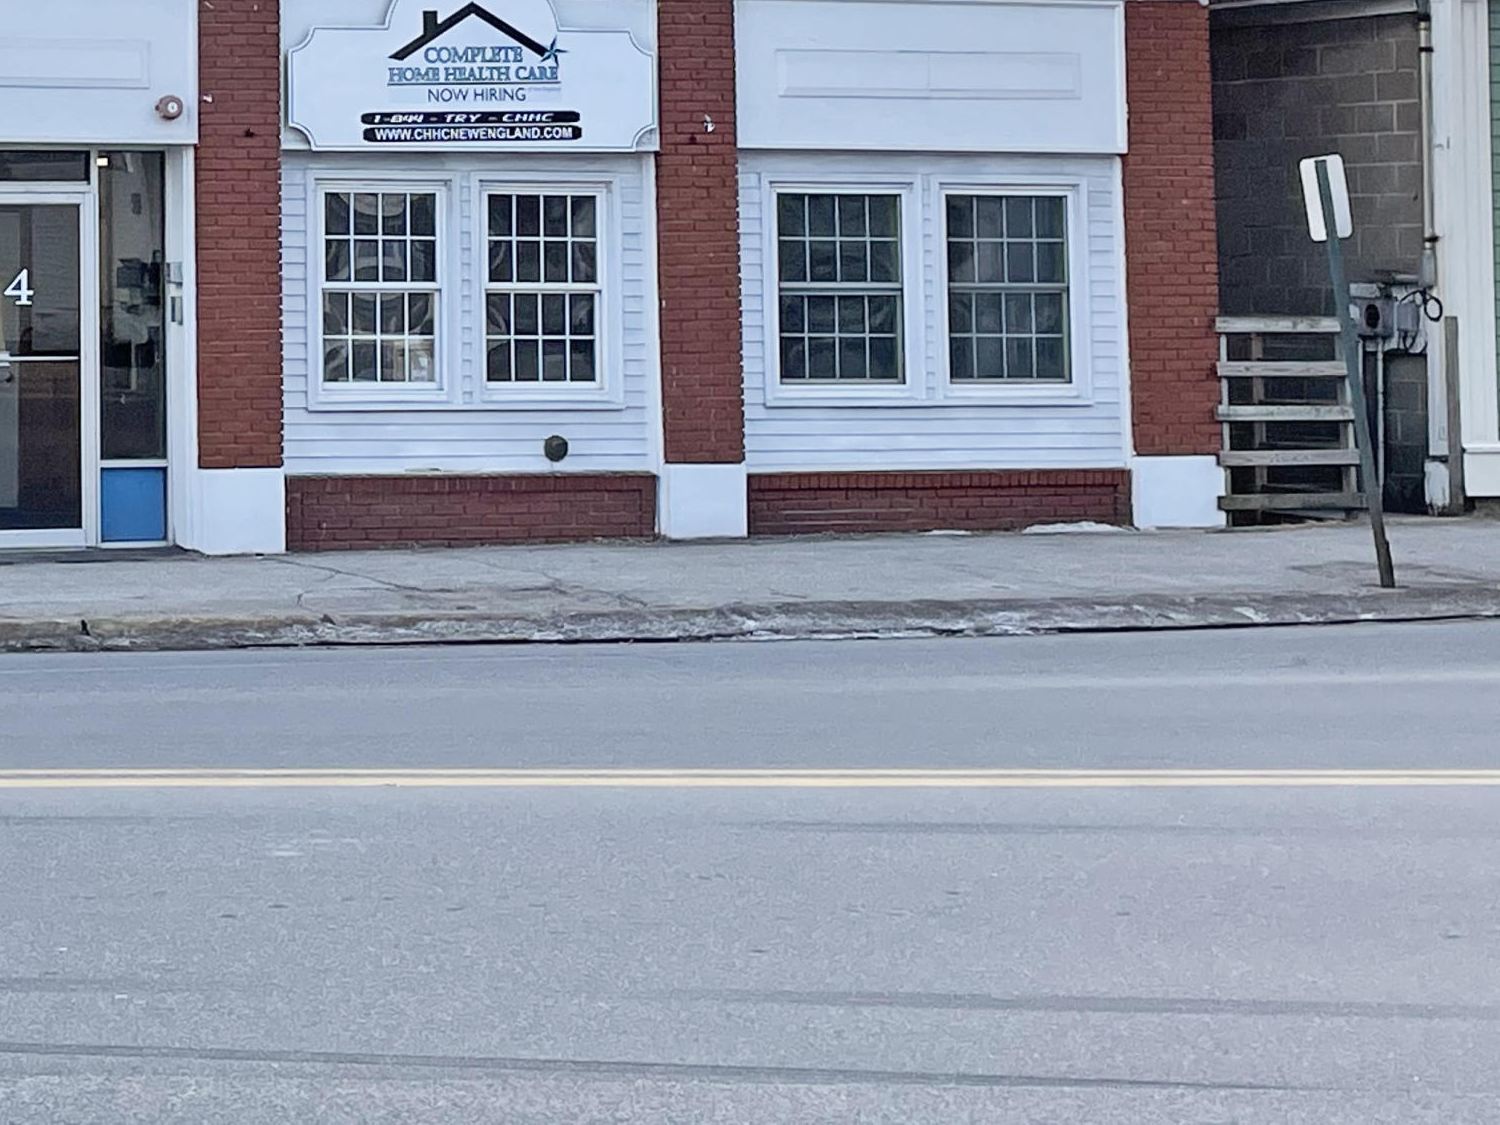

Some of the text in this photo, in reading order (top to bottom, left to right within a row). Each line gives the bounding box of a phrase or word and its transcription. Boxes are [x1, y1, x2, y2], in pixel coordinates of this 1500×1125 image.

[424, 46, 523, 64] COMPLETE
[388, 65, 559, 82] HOME HEALTH CARE
[427, 88, 468, 102] NOW
[473, 87, 526, 102] HIRING
[444, 113, 482, 123] TRY
[374, 126, 573, 141] WWW.CHHCNEWENGLAND.COM
[4, 268, 34, 306] 4
